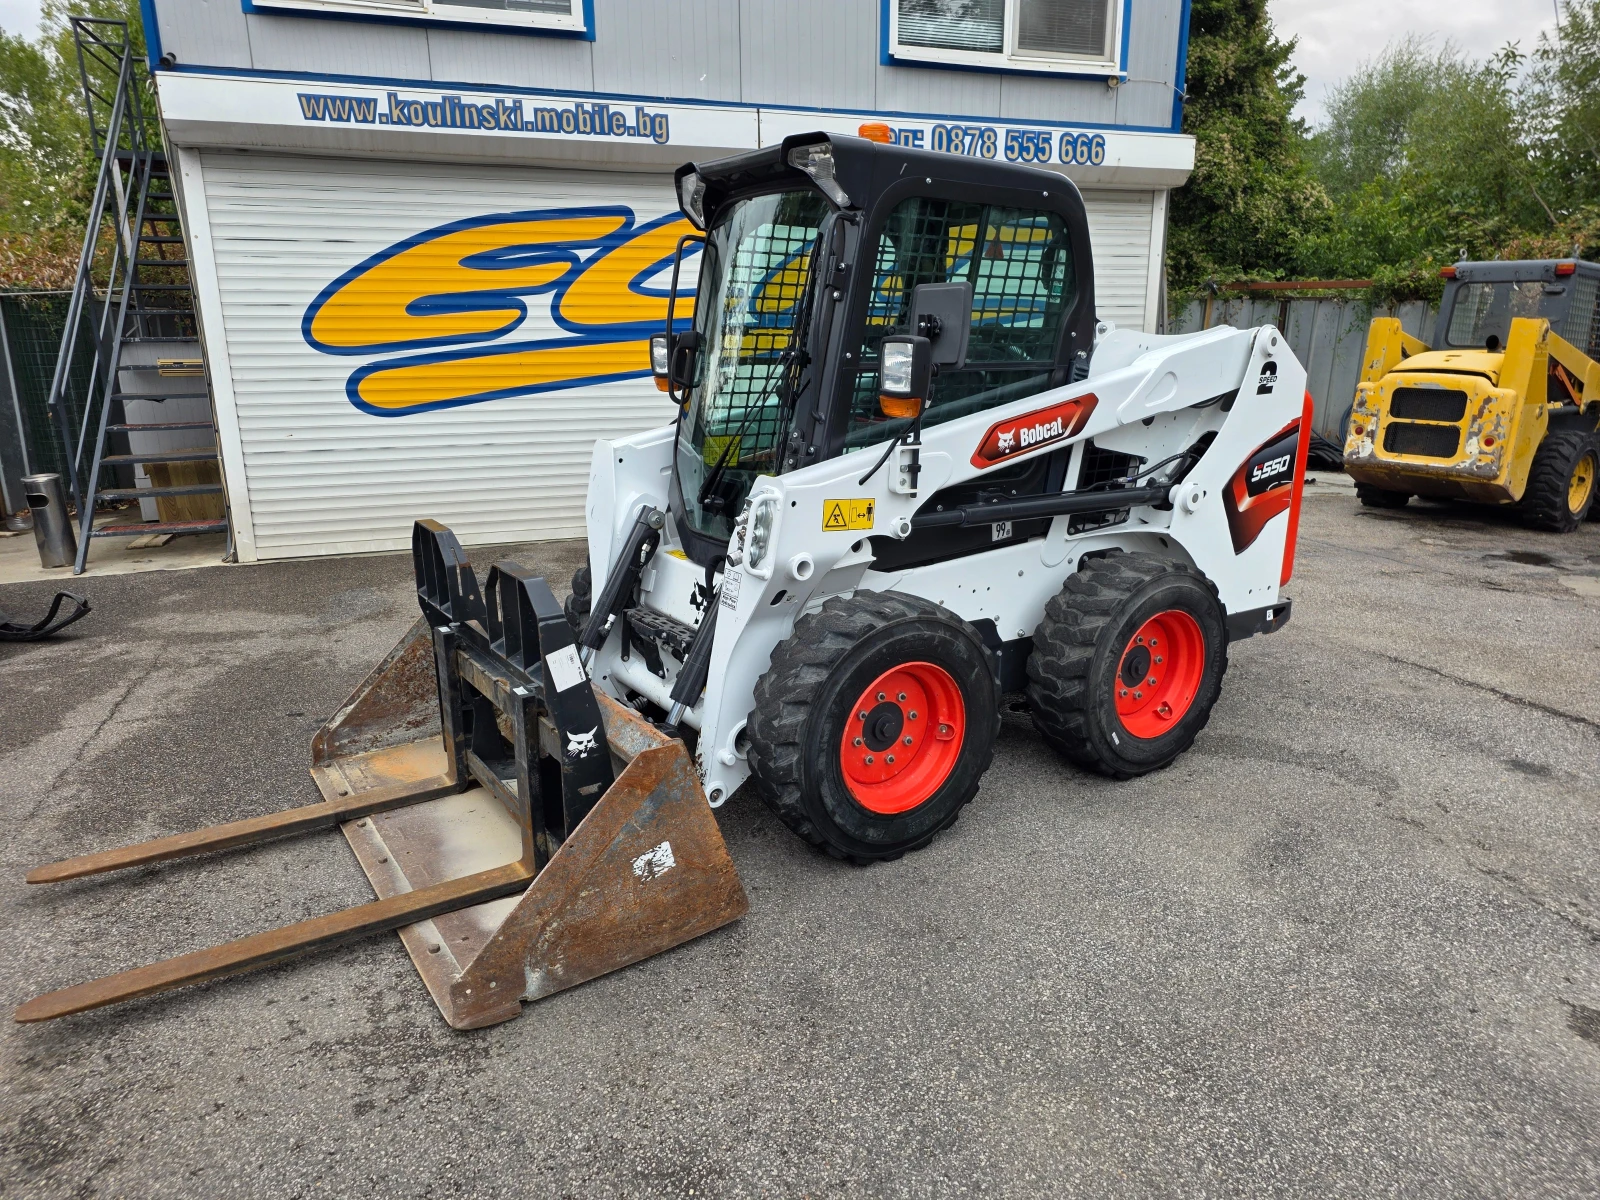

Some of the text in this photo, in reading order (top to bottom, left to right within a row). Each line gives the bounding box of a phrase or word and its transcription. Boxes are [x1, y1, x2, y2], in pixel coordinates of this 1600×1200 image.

[297, 92, 669, 144] www.koulinski.mobile.bg
[931, 123, 997, 159] 0878
[1004, 128, 1052, 163] 555
[1058, 132, 1106, 166] 666
[1256, 360, 1278, 395] 2
[1258, 375, 1278, 384] SPEED
[1019, 416, 1063, 447] Bobcat
[1251, 454, 1291, 482] S550
[995, 521, 1006, 539] 99
